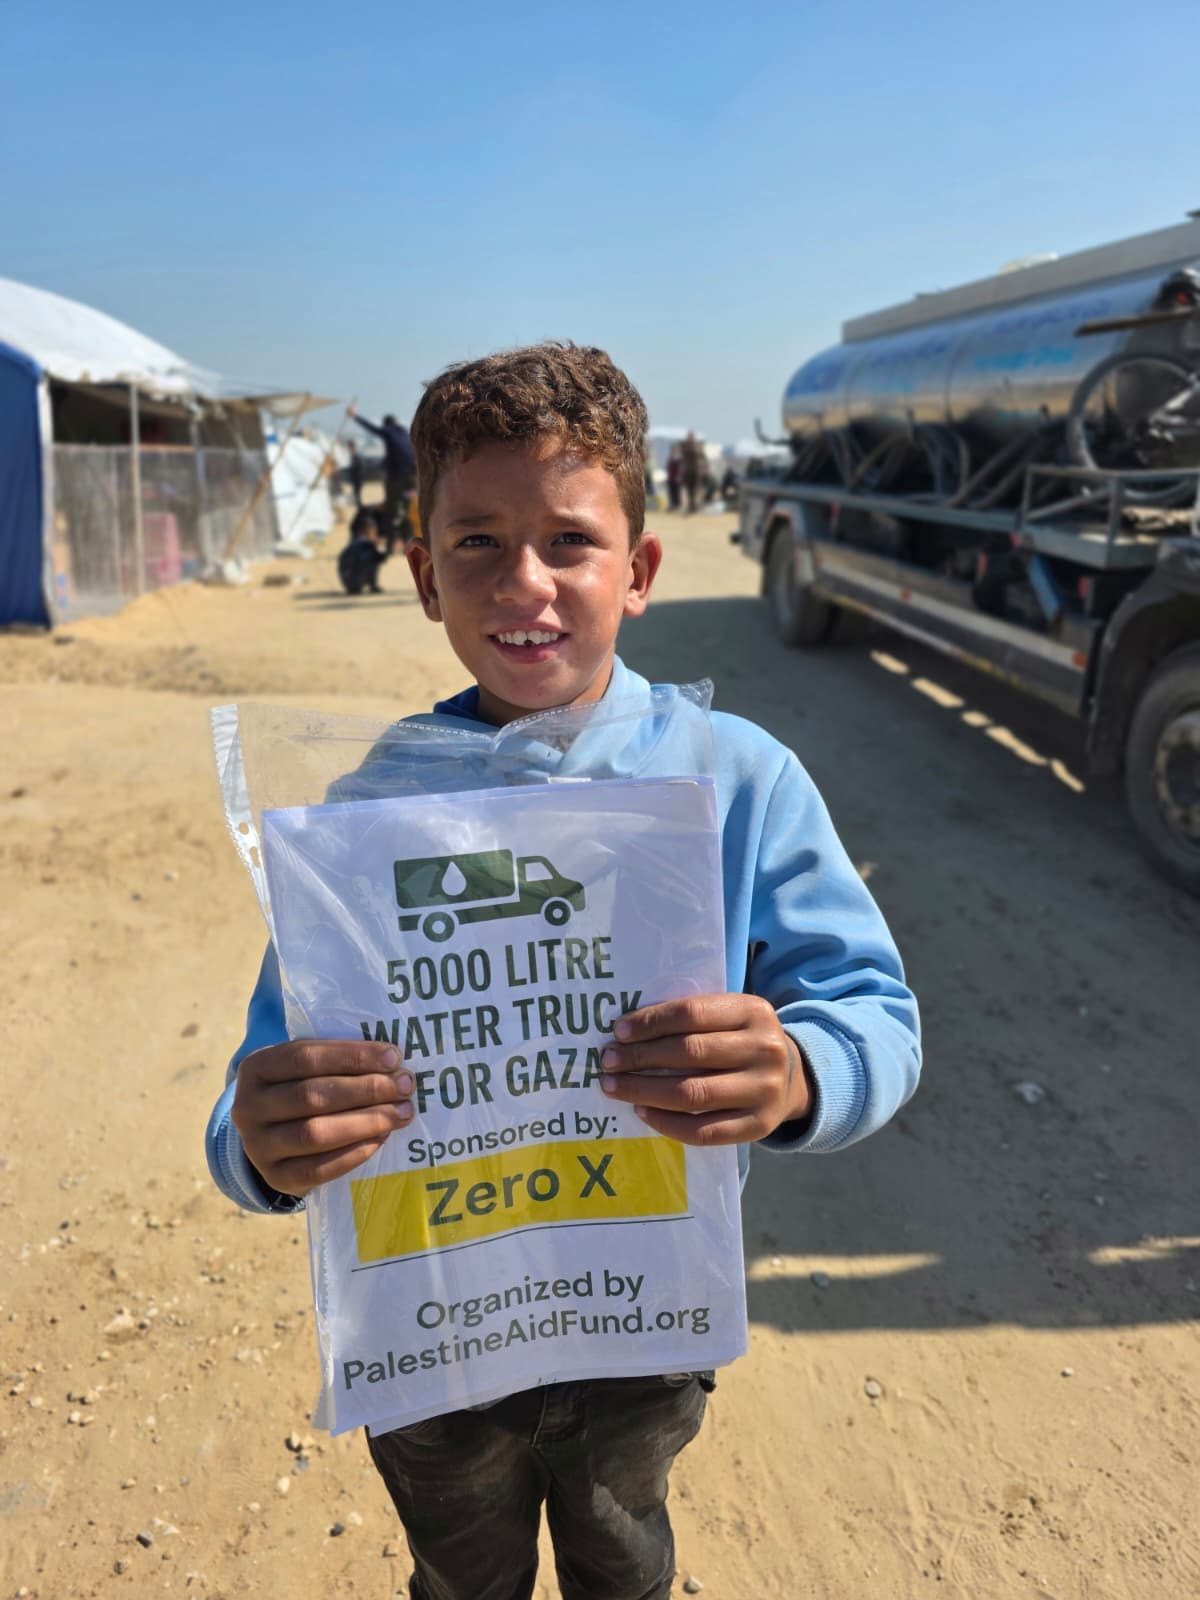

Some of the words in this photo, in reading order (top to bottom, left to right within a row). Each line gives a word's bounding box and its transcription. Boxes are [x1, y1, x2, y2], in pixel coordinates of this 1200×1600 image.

[387, 948, 492, 1004] 5000
[504, 936, 615, 988] LITRE
[414, 1062, 494, 1114] FOR
[505, 1047, 604, 1097] GAZA
[408, 1112, 566, 1167] Sponsored
[574, 1111, 618, 1140] by:
[425, 1167, 560, 1227] Zero
[576, 1153, 617, 1199] X
[416, 1271, 593, 1330] Organized
[604, 1269, 645, 1302] by
[343, 1305, 711, 1391] PalestineAidFund.org
